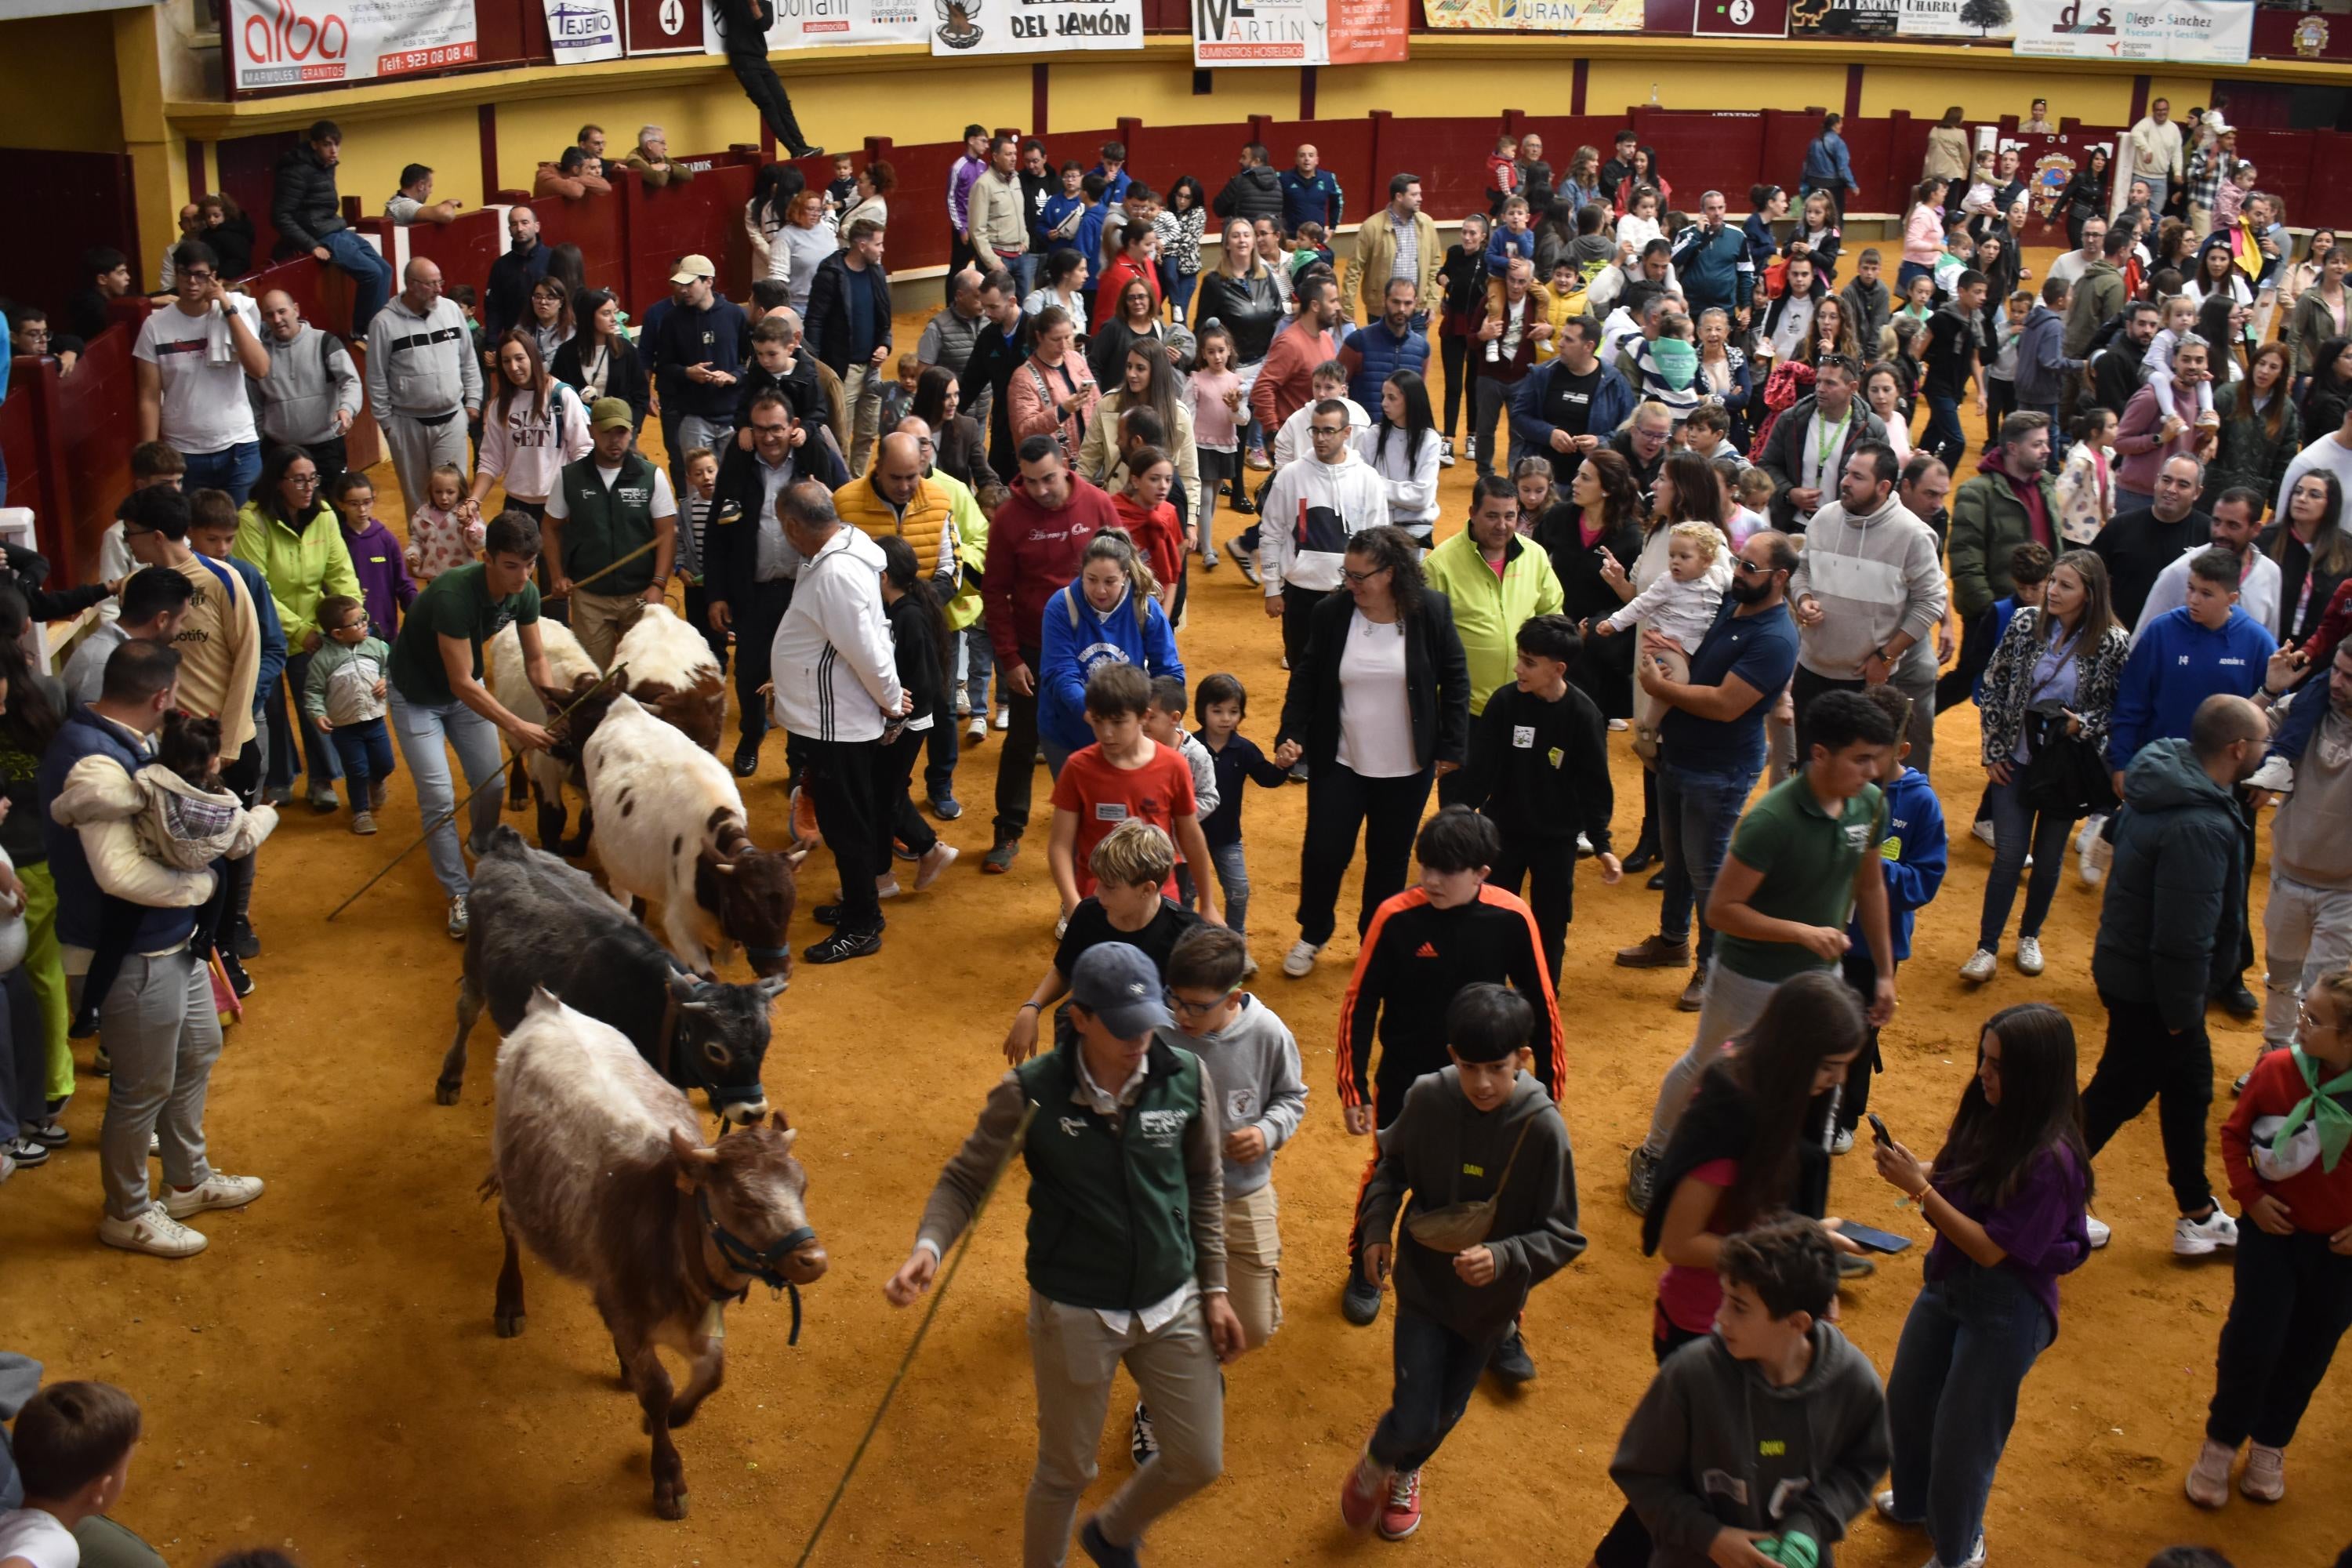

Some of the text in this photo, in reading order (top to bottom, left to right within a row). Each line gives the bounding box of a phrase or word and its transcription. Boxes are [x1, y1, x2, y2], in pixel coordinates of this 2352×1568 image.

[665, 0, 677, 31] 4
[1197, 0, 1305, 41] MARTÍN
[1736, 1, 1748, 21] 3
[2126, 12, 2155, 27] Diego
[245, 0, 348, 64] alba
[1011, 8, 1131, 37] DEL JAMÓN
[1200, 45, 1303, 59] SUMINISTROS HOSTELEROS
[2122, 42, 2152, 50] Seguros
[381, 45, 474, 72] Telf: 923 08 08 41
[244, 70, 294, 83] MARMOLES
[301, 66, 345, 79] GRANITOS
[512, 429, 550, 448] SET
[173, 629, 209, 643] otify
[2179, 655, 2189, 666] 14
